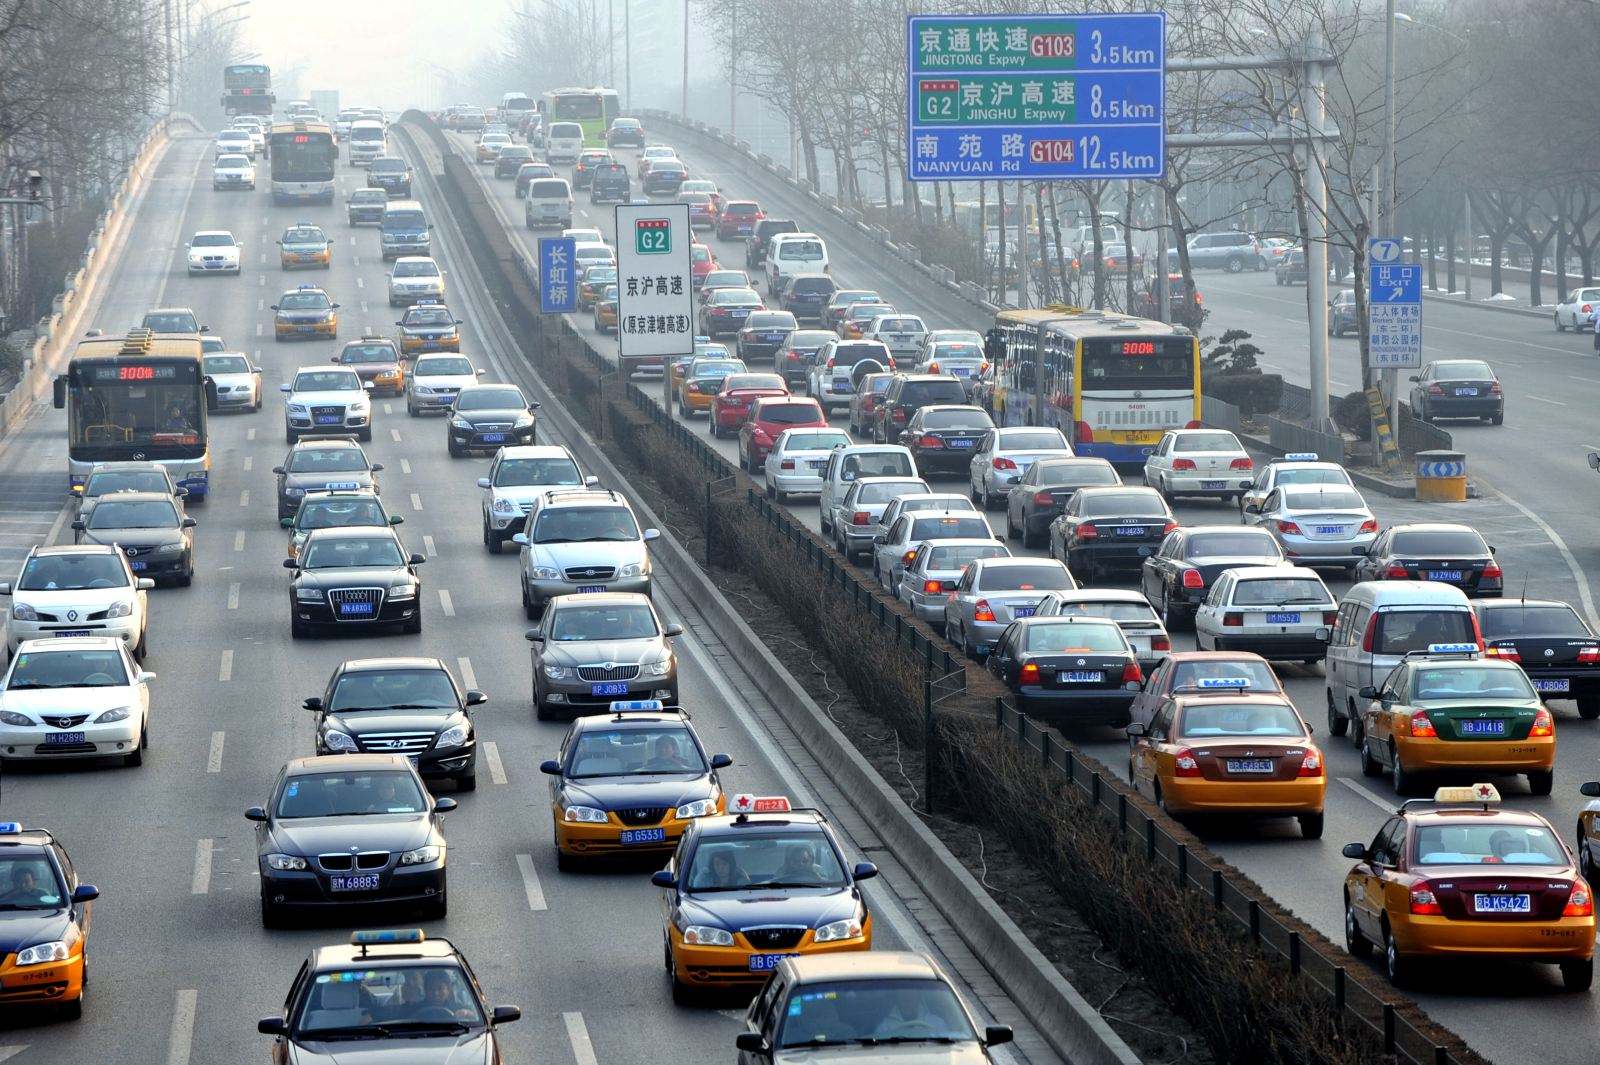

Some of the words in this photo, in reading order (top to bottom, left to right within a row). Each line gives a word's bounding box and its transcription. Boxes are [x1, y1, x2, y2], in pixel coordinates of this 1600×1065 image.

[919, 27, 1028, 52] 京通快速
[1031, 36, 1073, 56] G103
[921, 54, 982, 66] JINGTONG
[989, 54, 1026, 67] Expwy
[961, 80, 1075, 105] 京沪高速
[927, 96, 952, 115] G2
[966, 108, 1017, 120] JINGHU
[1024, 108, 1066, 121] Expwy
[916, 134, 1025, 158] 南苑路
[1031, 141, 1073, 162] G104
[917, 160, 993, 173] NANYUAN
[1002, 160, 1020, 172] Rd
[642, 231, 665, 249] G2
[1380, 243, 1391, 259] 7
[549, 246, 568, 305] 长虹桥
[1380, 266, 1412, 279] 出口
[626, 275, 683, 296] 京沪高速
[1371, 306, 1419, 317] 工人体育场
